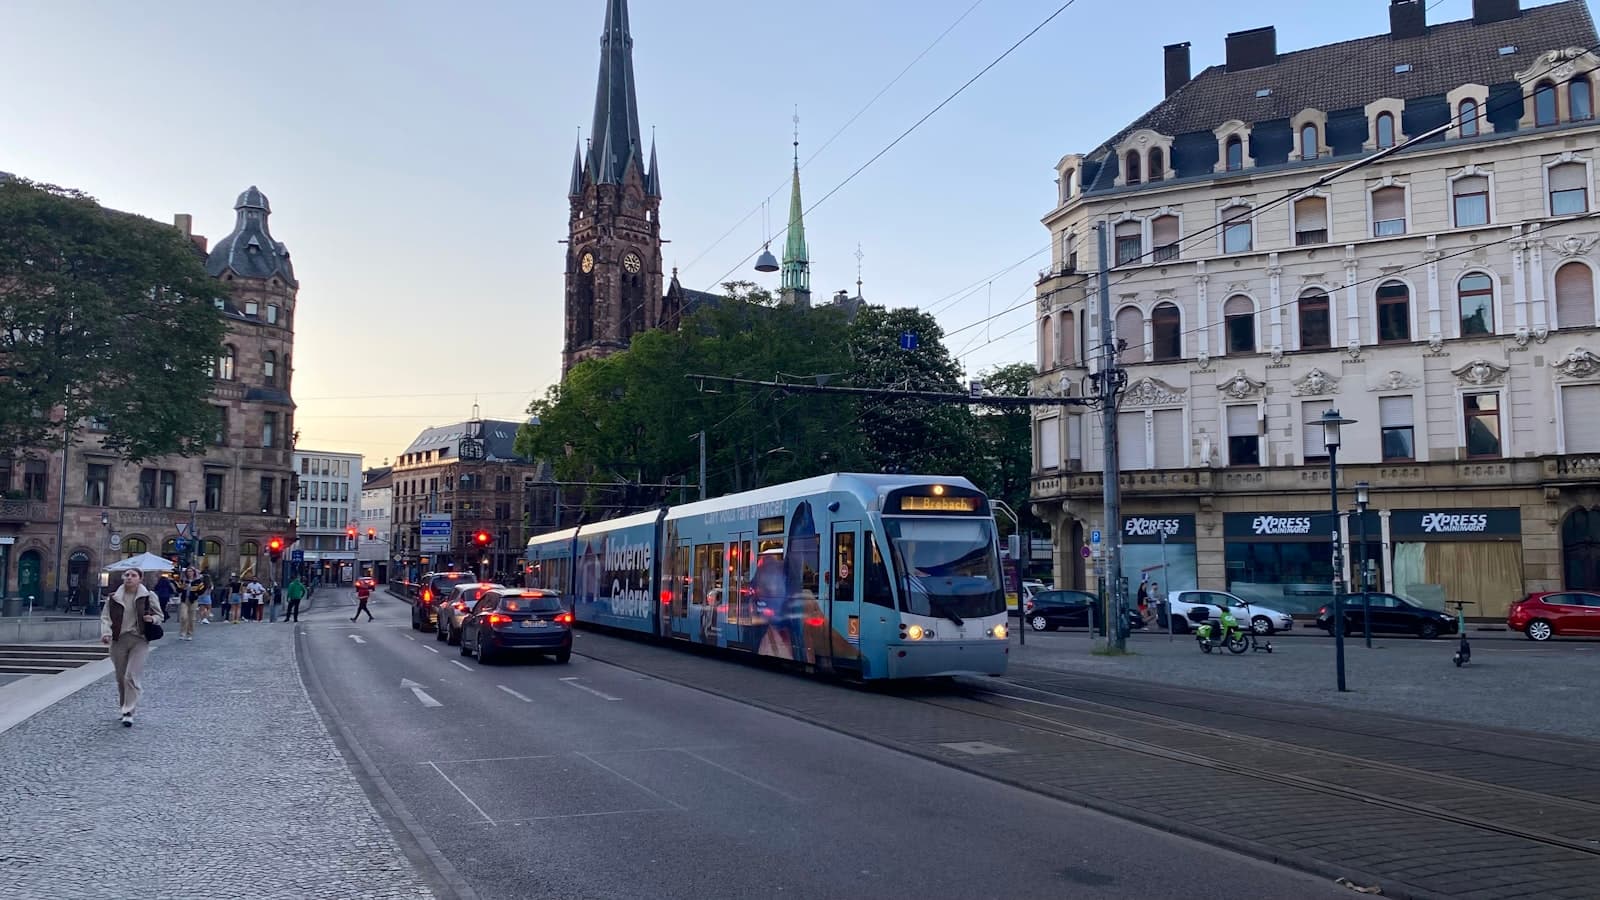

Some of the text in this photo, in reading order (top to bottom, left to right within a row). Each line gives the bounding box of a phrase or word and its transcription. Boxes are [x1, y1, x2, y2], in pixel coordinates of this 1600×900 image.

[923, 497, 968, 510] Brebach
[605, 534, 652, 572] Moderne
[611, 578, 650, 618] Galerie
